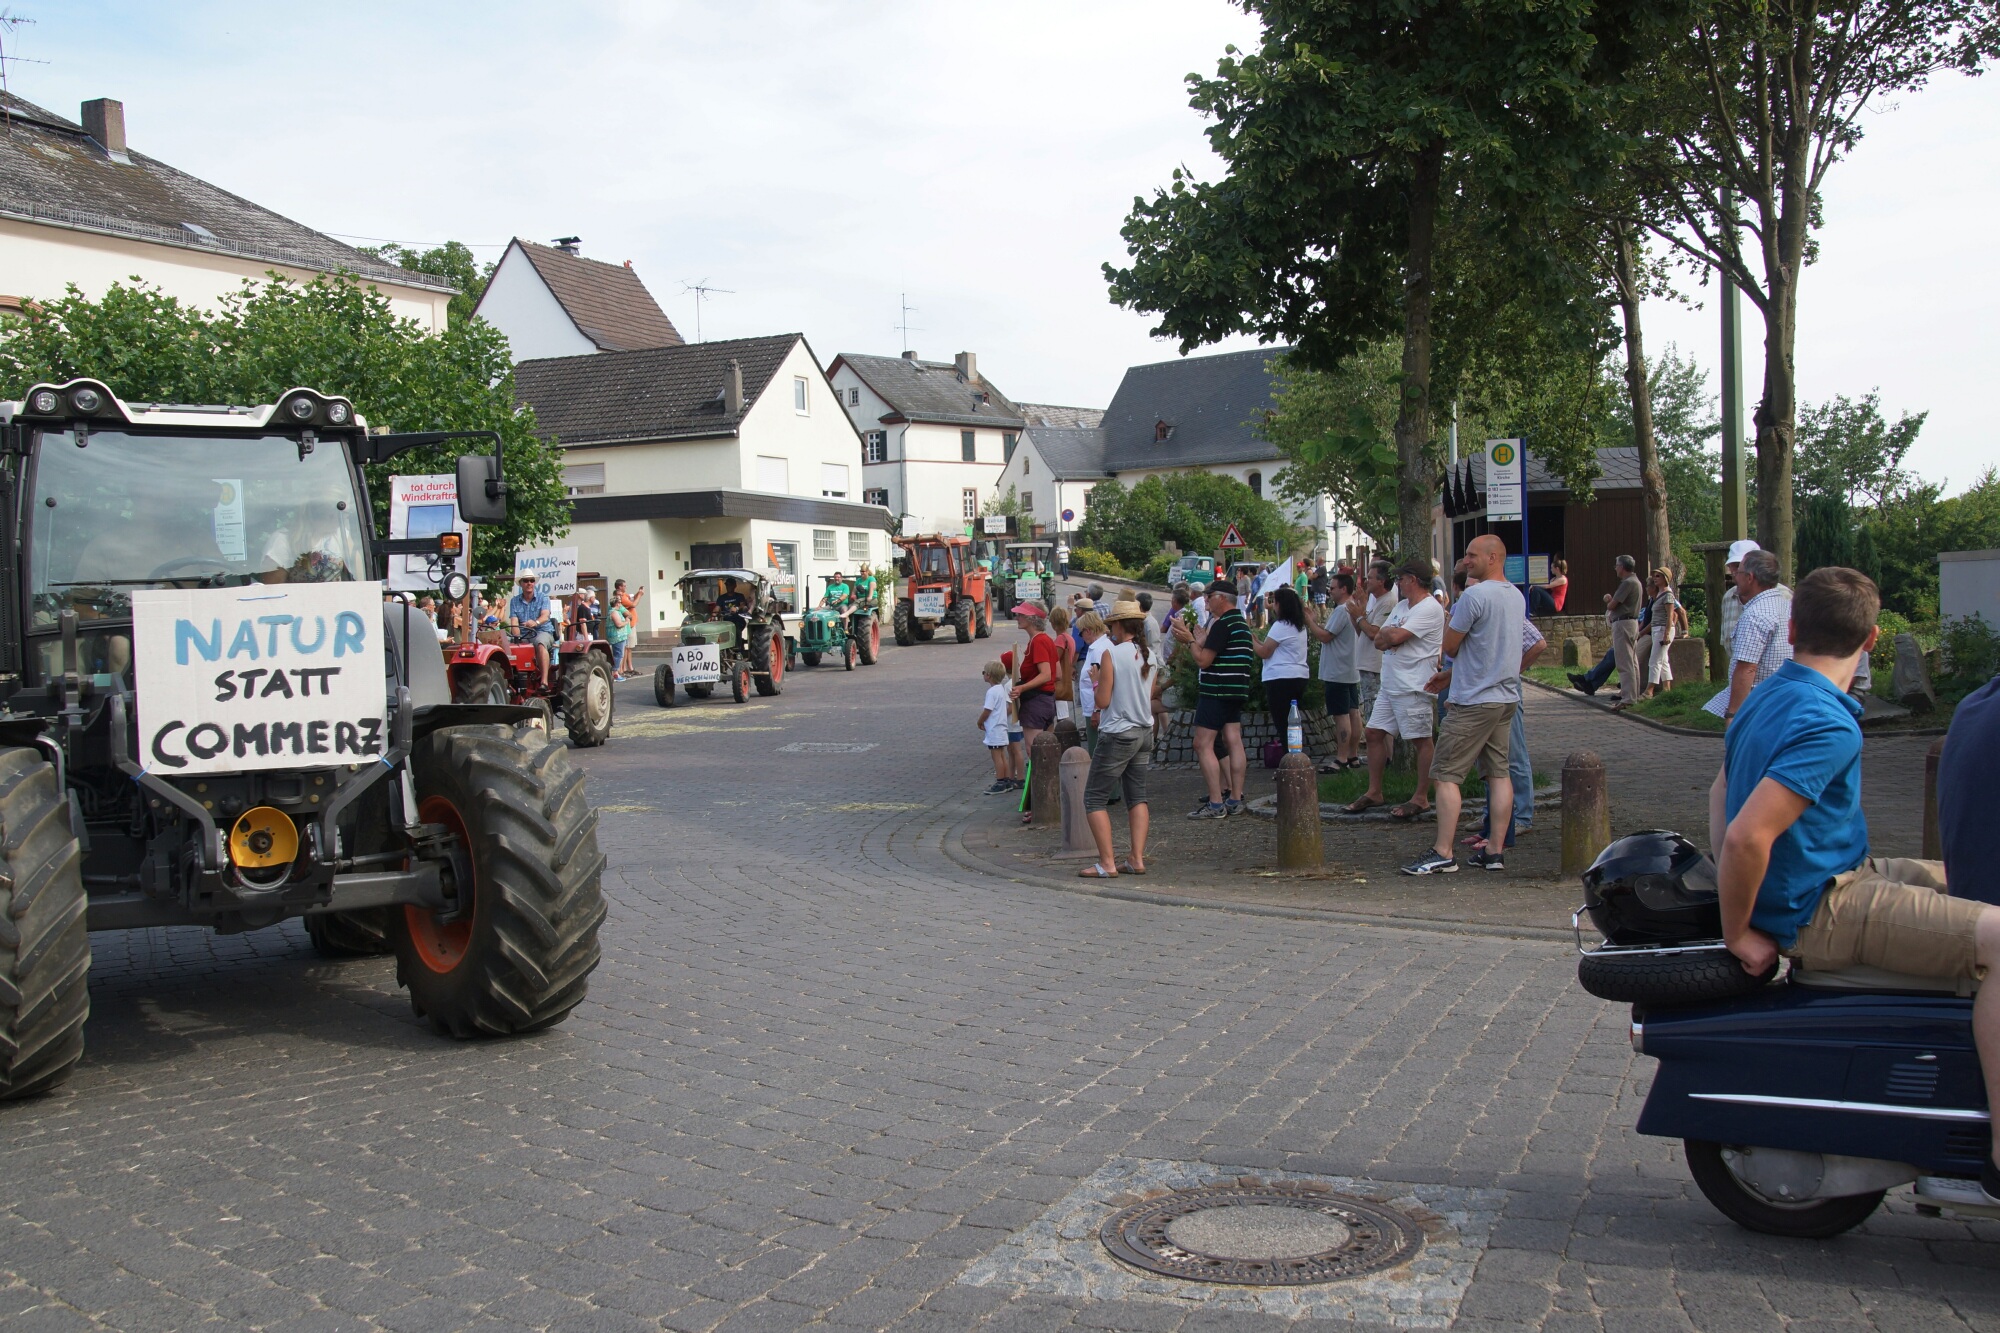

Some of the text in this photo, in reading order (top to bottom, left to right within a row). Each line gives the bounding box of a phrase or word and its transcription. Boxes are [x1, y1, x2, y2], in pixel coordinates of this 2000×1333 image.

[410, 481, 455, 492] tot durch
[401, 492, 458, 502] Windkraftra
[520, 556, 558, 570] NATUR
[554, 583, 575, 591] PARK
[175, 611, 366, 666] NATUR
[690, 661, 719, 671] WIND
[214, 667, 342, 703] STATT
[151, 717, 383, 769] COMMERZ
